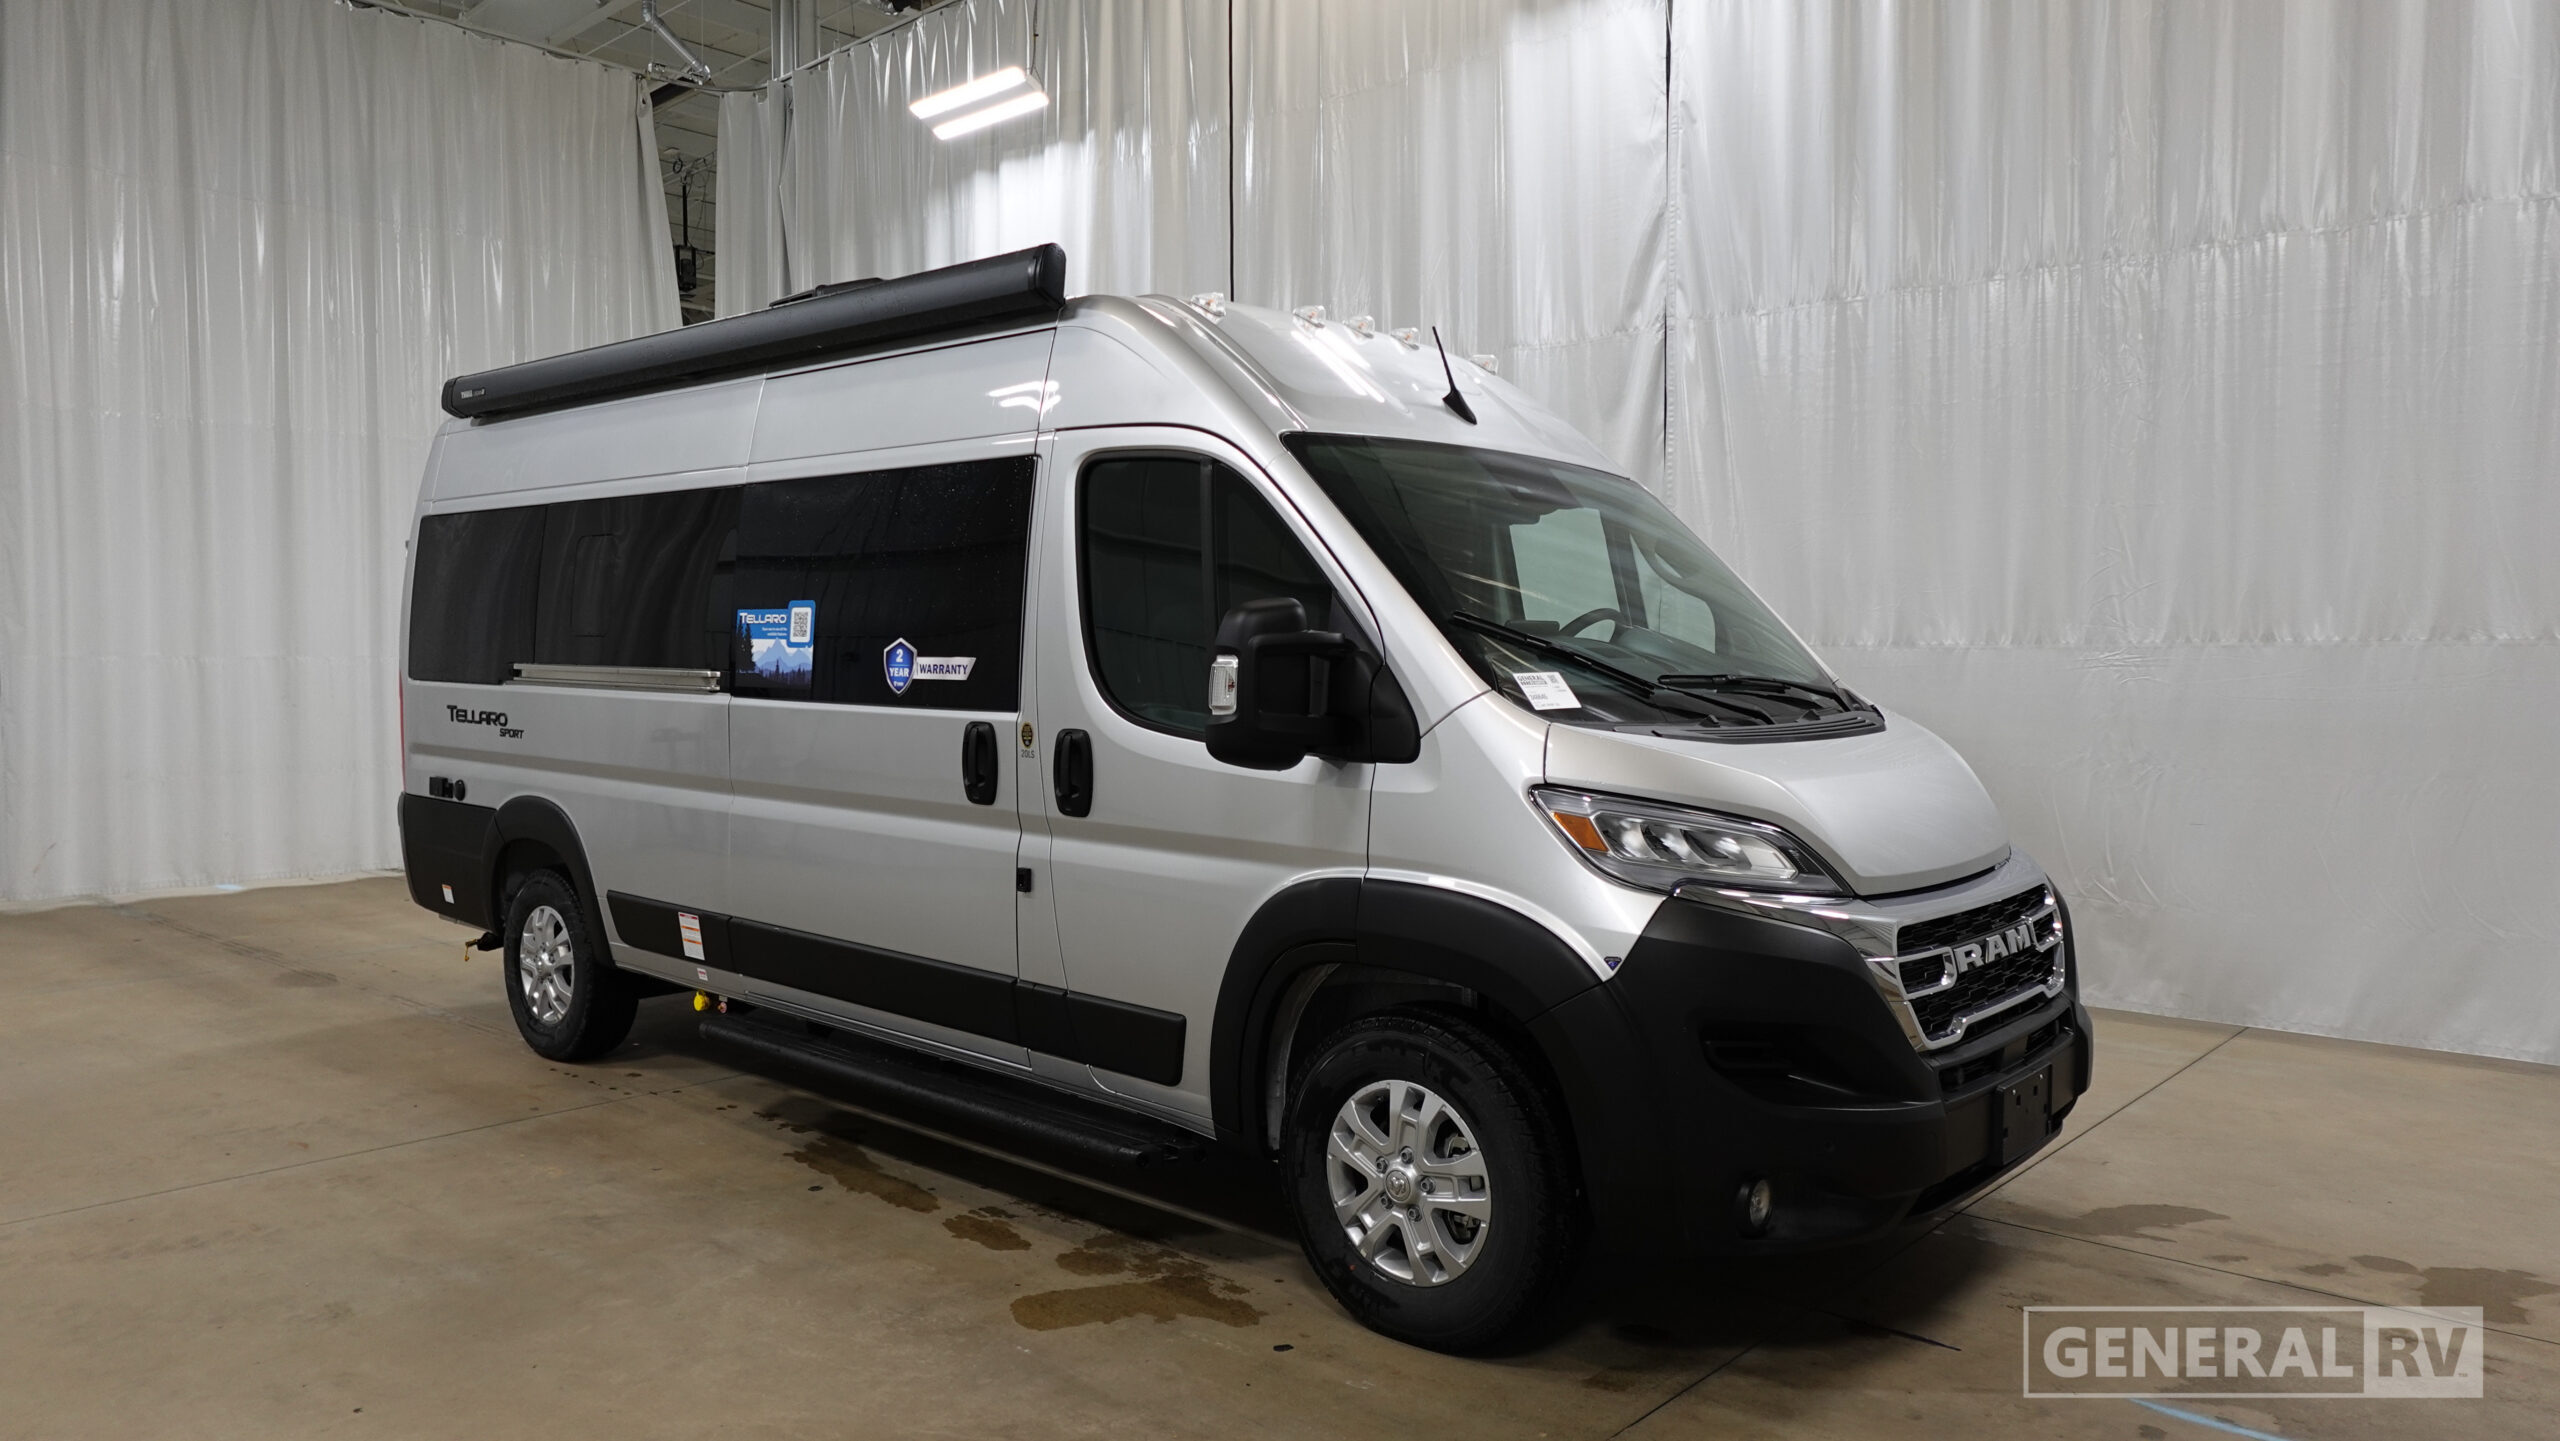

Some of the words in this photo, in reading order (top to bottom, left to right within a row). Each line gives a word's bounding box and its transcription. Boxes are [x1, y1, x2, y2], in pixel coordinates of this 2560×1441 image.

[740, 613, 787, 624] TELLARO
[896, 649, 904, 663] 2
[889, 668, 909, 677] YEAR
[919, 664, 967, 675] WARRANTY
[446, 704, 508, 727] TELLARO
[499, 728, 524, 739] SPORT
[1953, 924, 2031, 974] RAM
